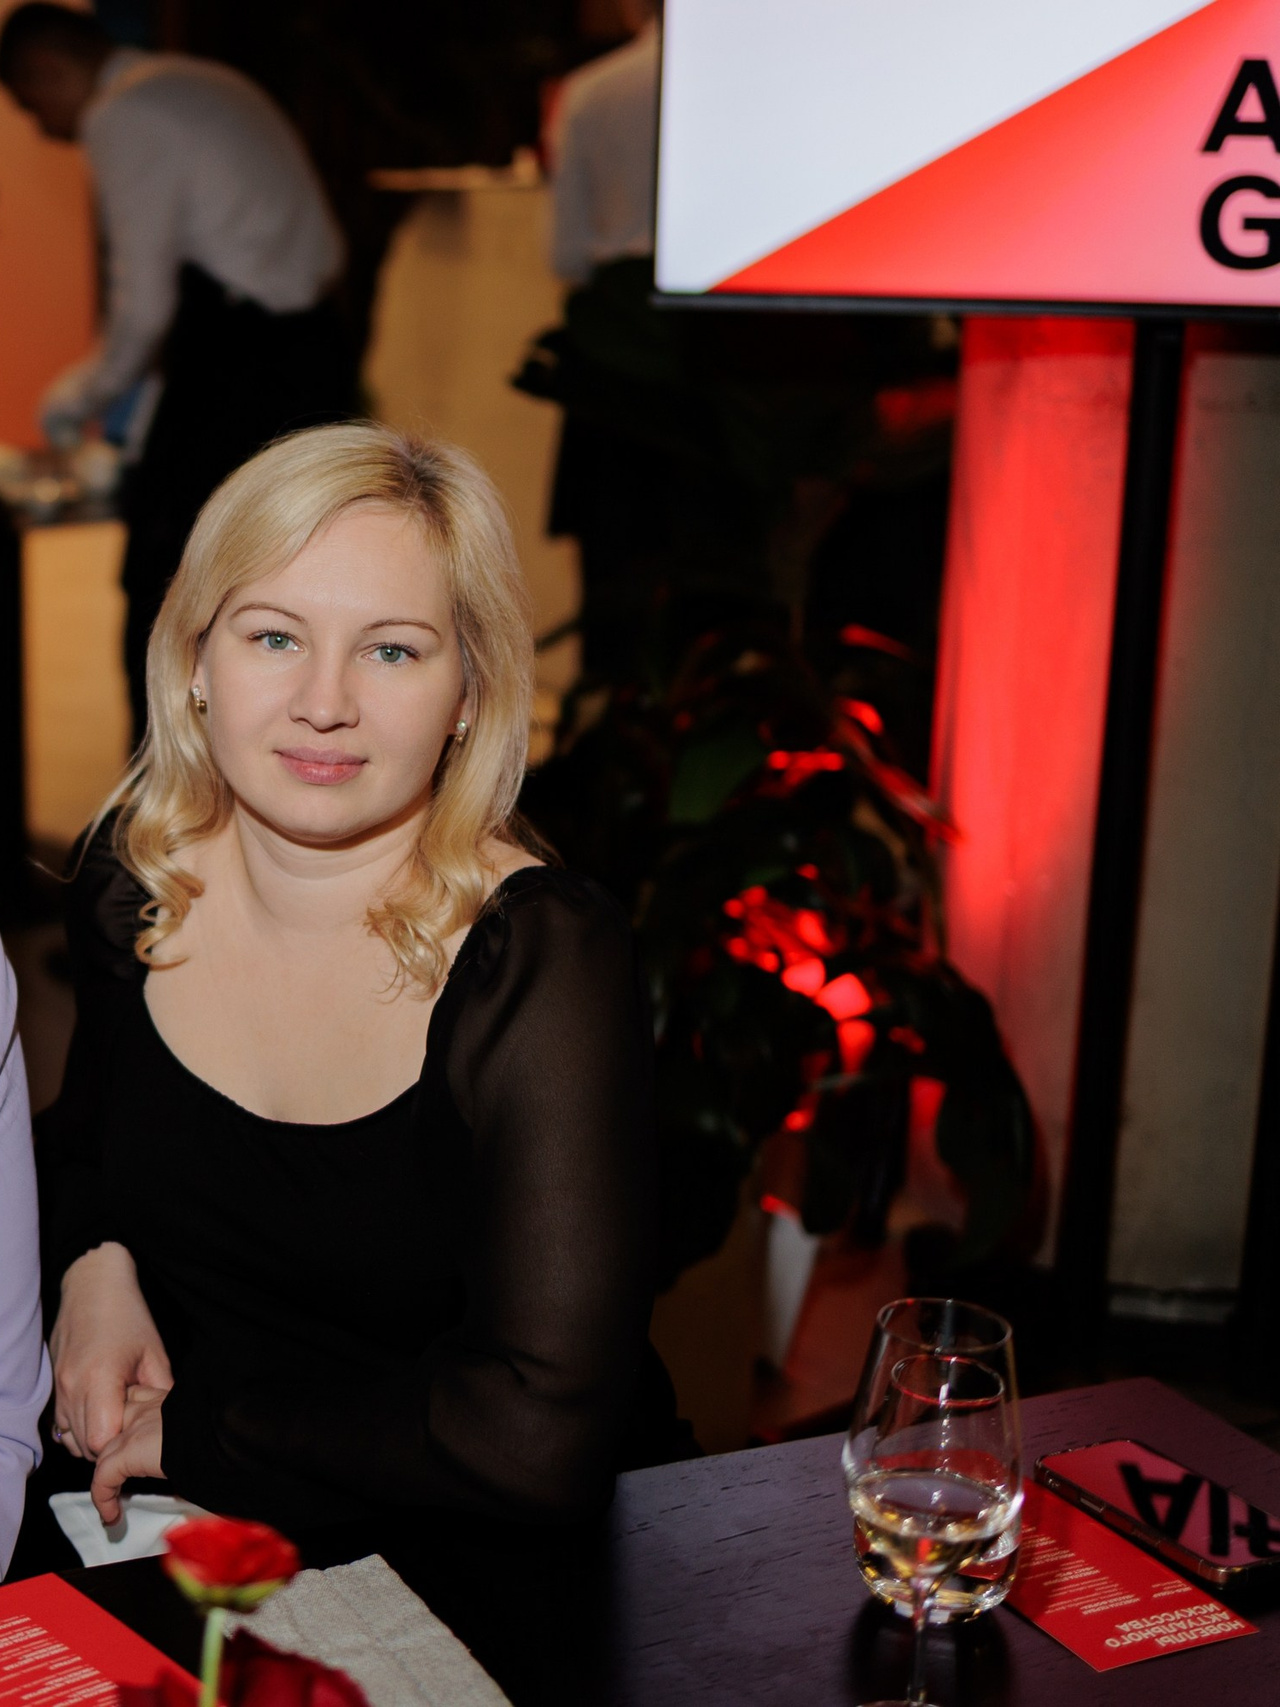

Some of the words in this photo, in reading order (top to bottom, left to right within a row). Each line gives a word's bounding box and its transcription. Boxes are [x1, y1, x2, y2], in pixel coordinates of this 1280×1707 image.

[1105, 1611, 1230, 1647] АКТУАЛЬНОГО
[1116, 1603, 1220, 1631] ИСКУССТВА
[1157, 1620, 1245, 1647] НОВЕЛЛЫ
